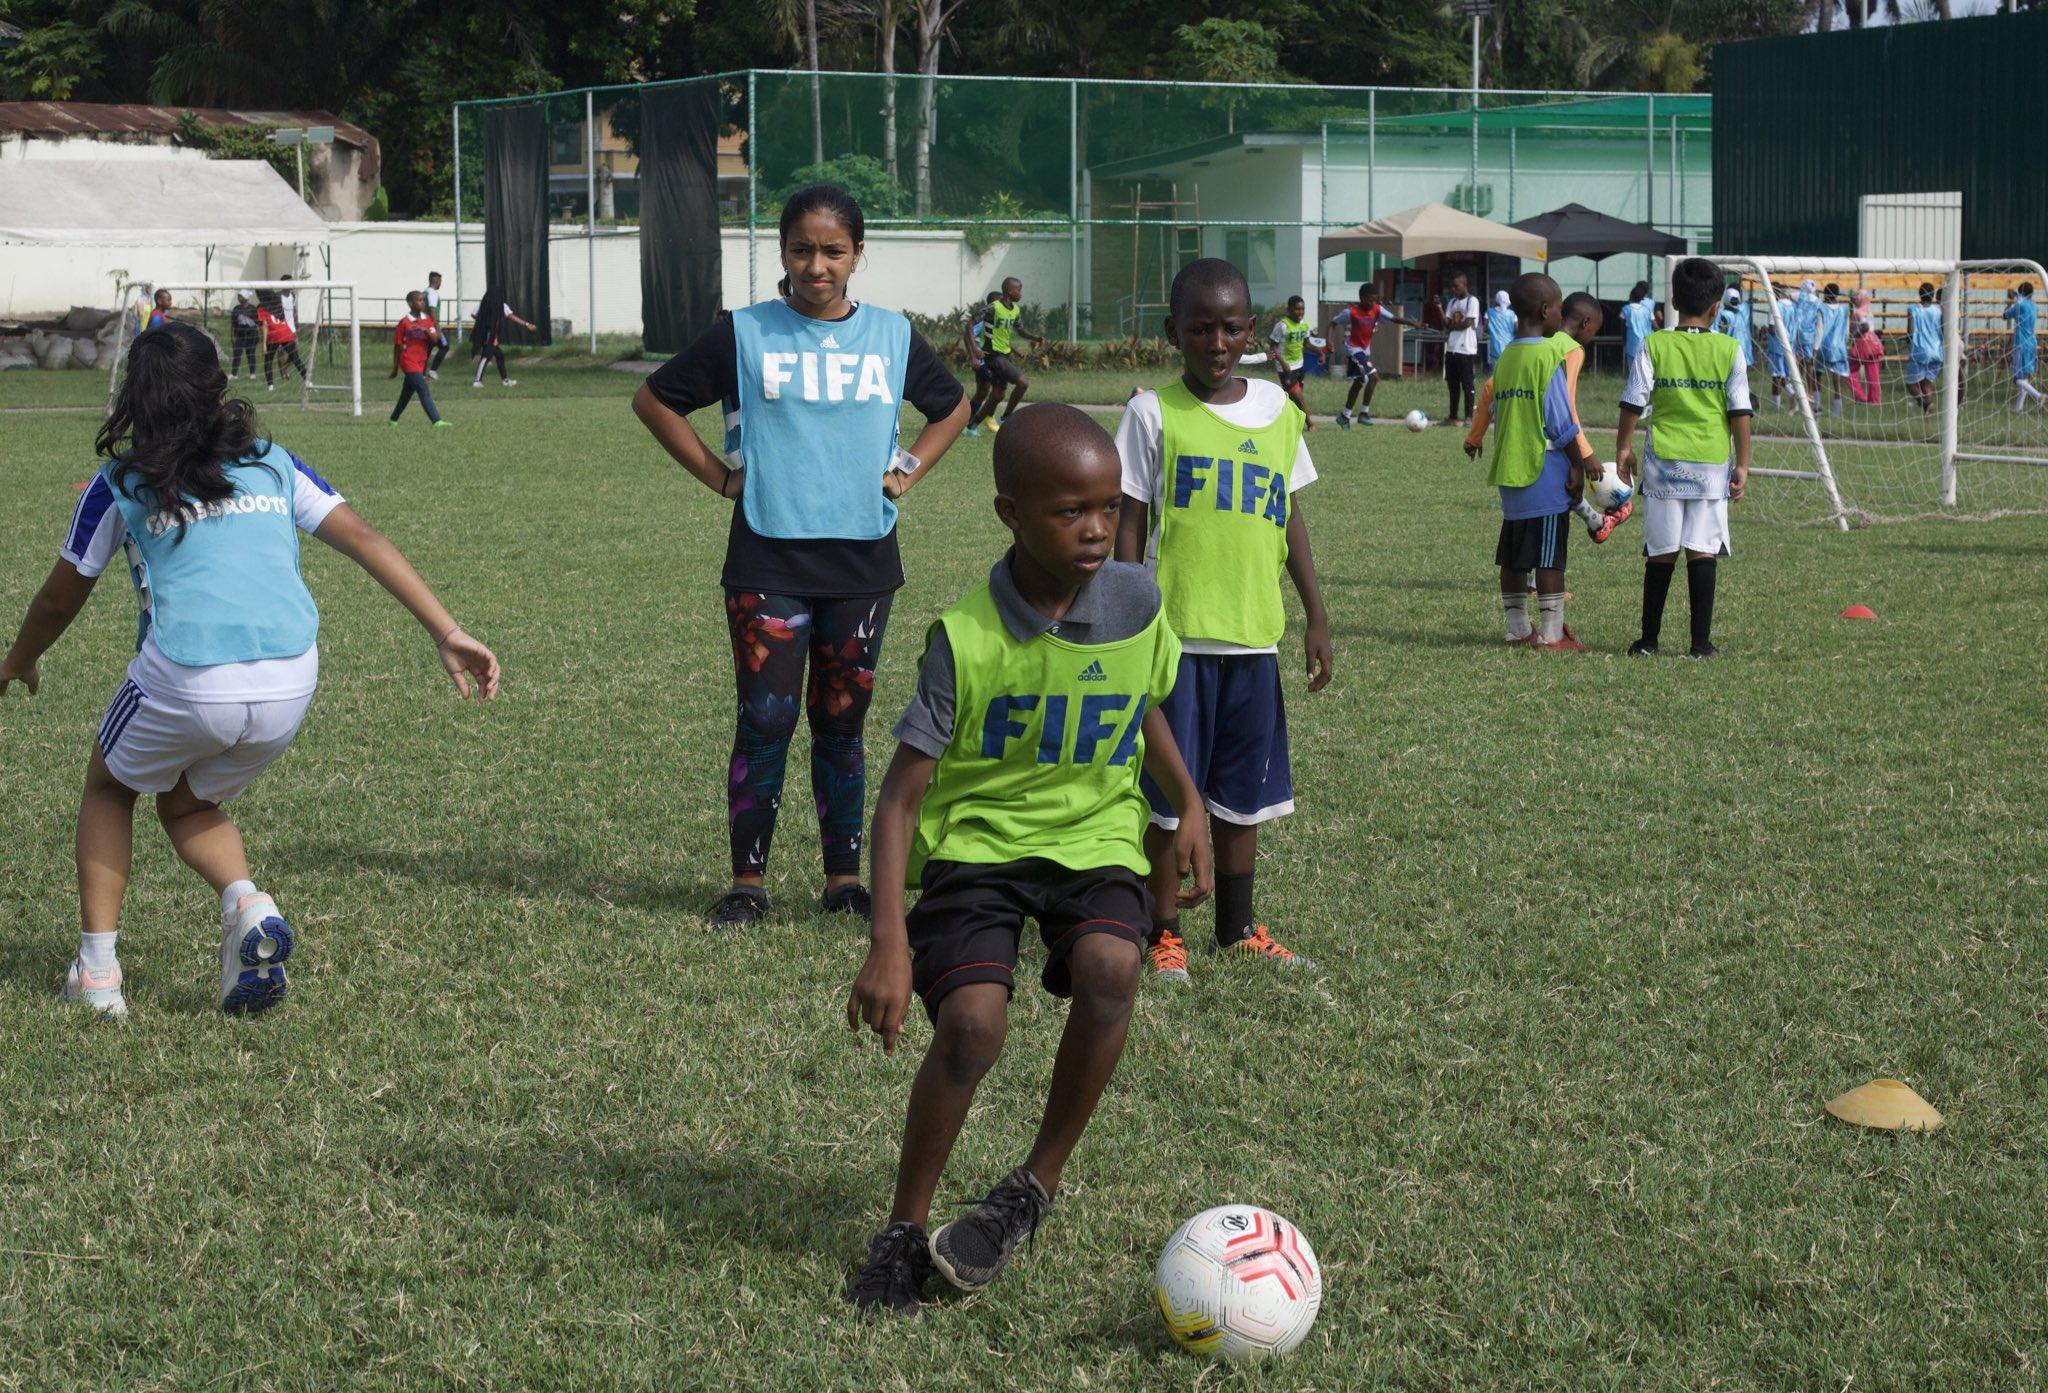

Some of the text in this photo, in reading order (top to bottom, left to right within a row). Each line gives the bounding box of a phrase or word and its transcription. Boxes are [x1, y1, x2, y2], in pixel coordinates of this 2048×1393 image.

[763, 352, 894, 404] FIFA
[1654, 378, 1729, 389] GRASSROOT
[1174, 455, 1287, 528] FIFA
[1077, 672, 1107, 681] adidas
